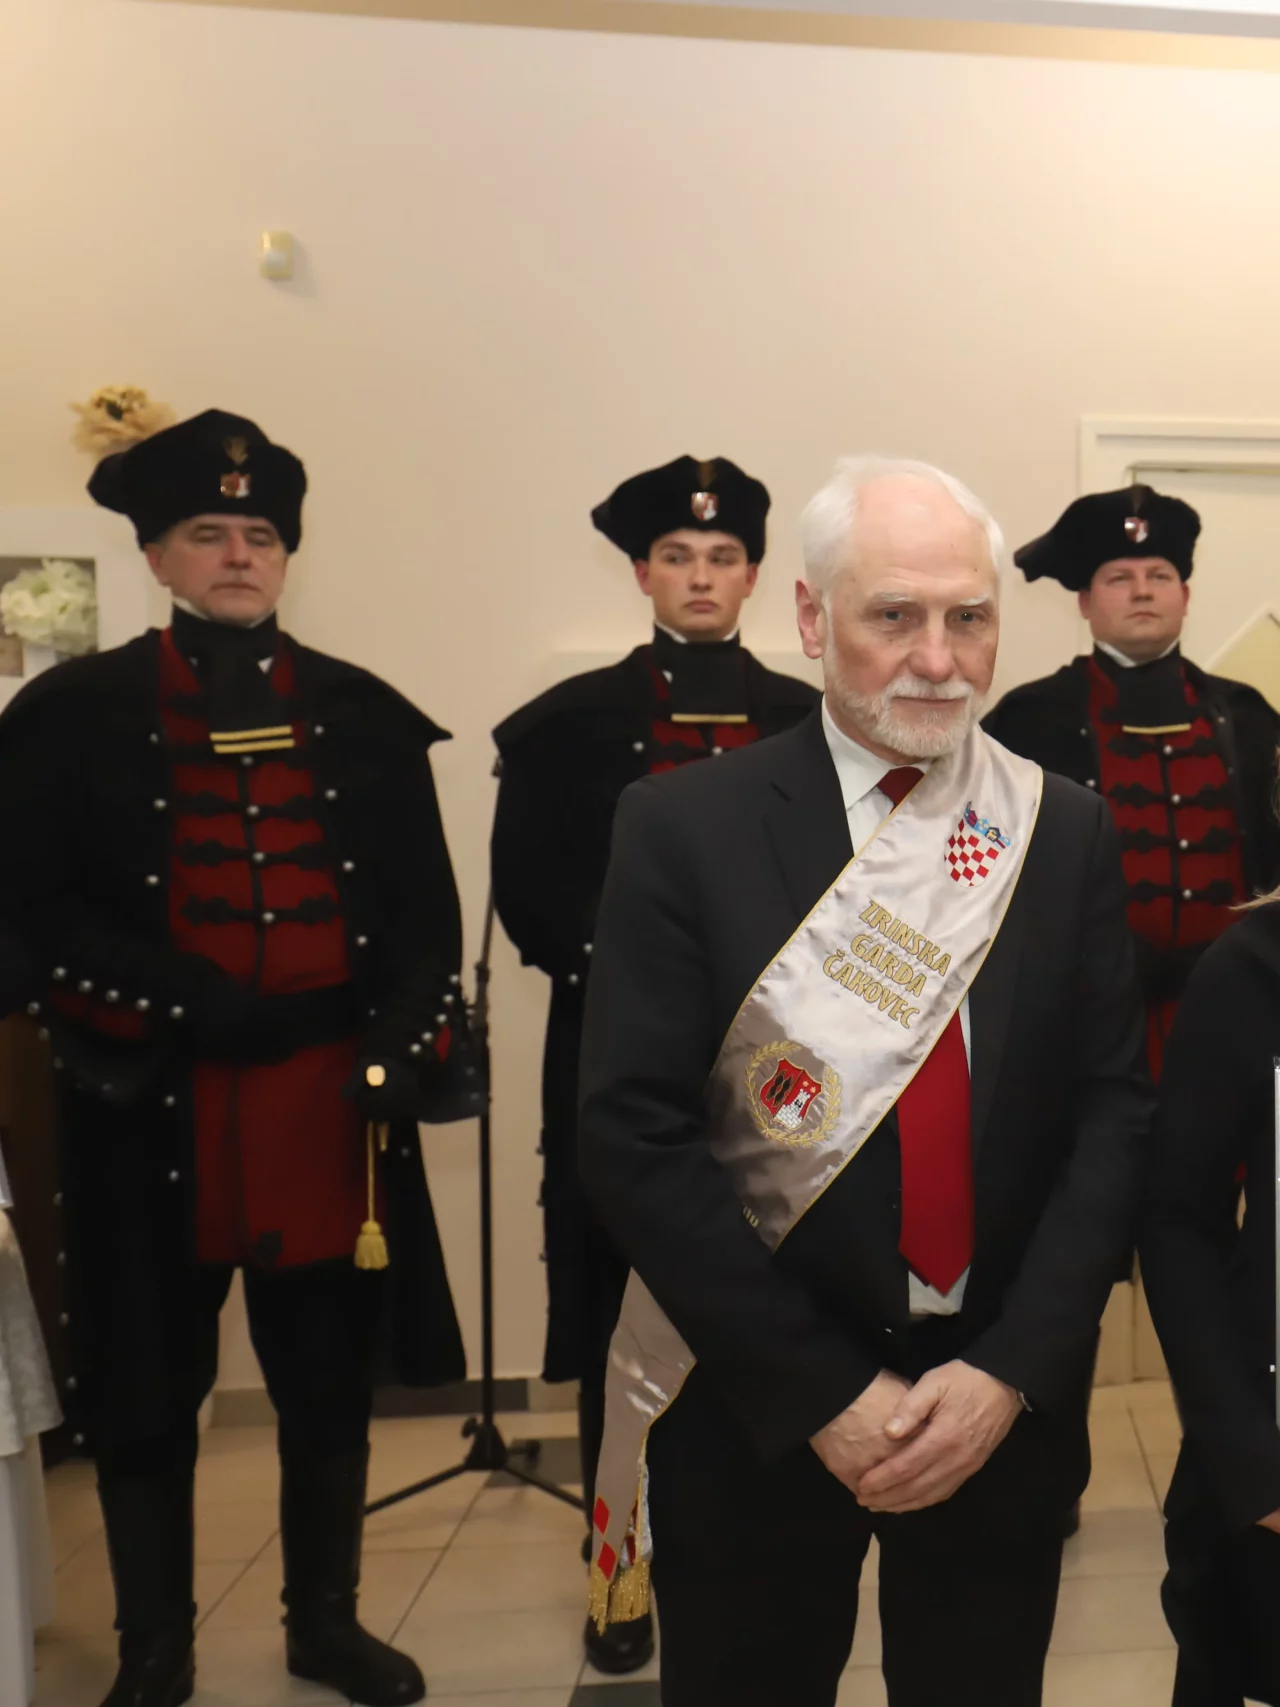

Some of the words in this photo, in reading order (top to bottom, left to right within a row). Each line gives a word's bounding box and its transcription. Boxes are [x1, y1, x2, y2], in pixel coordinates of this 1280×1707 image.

[850, 933, 927, 998] GARDA
[858, 899, 952, 977] ZRINSKA
[822, 949, 920, 1029] ČAKOVEC
